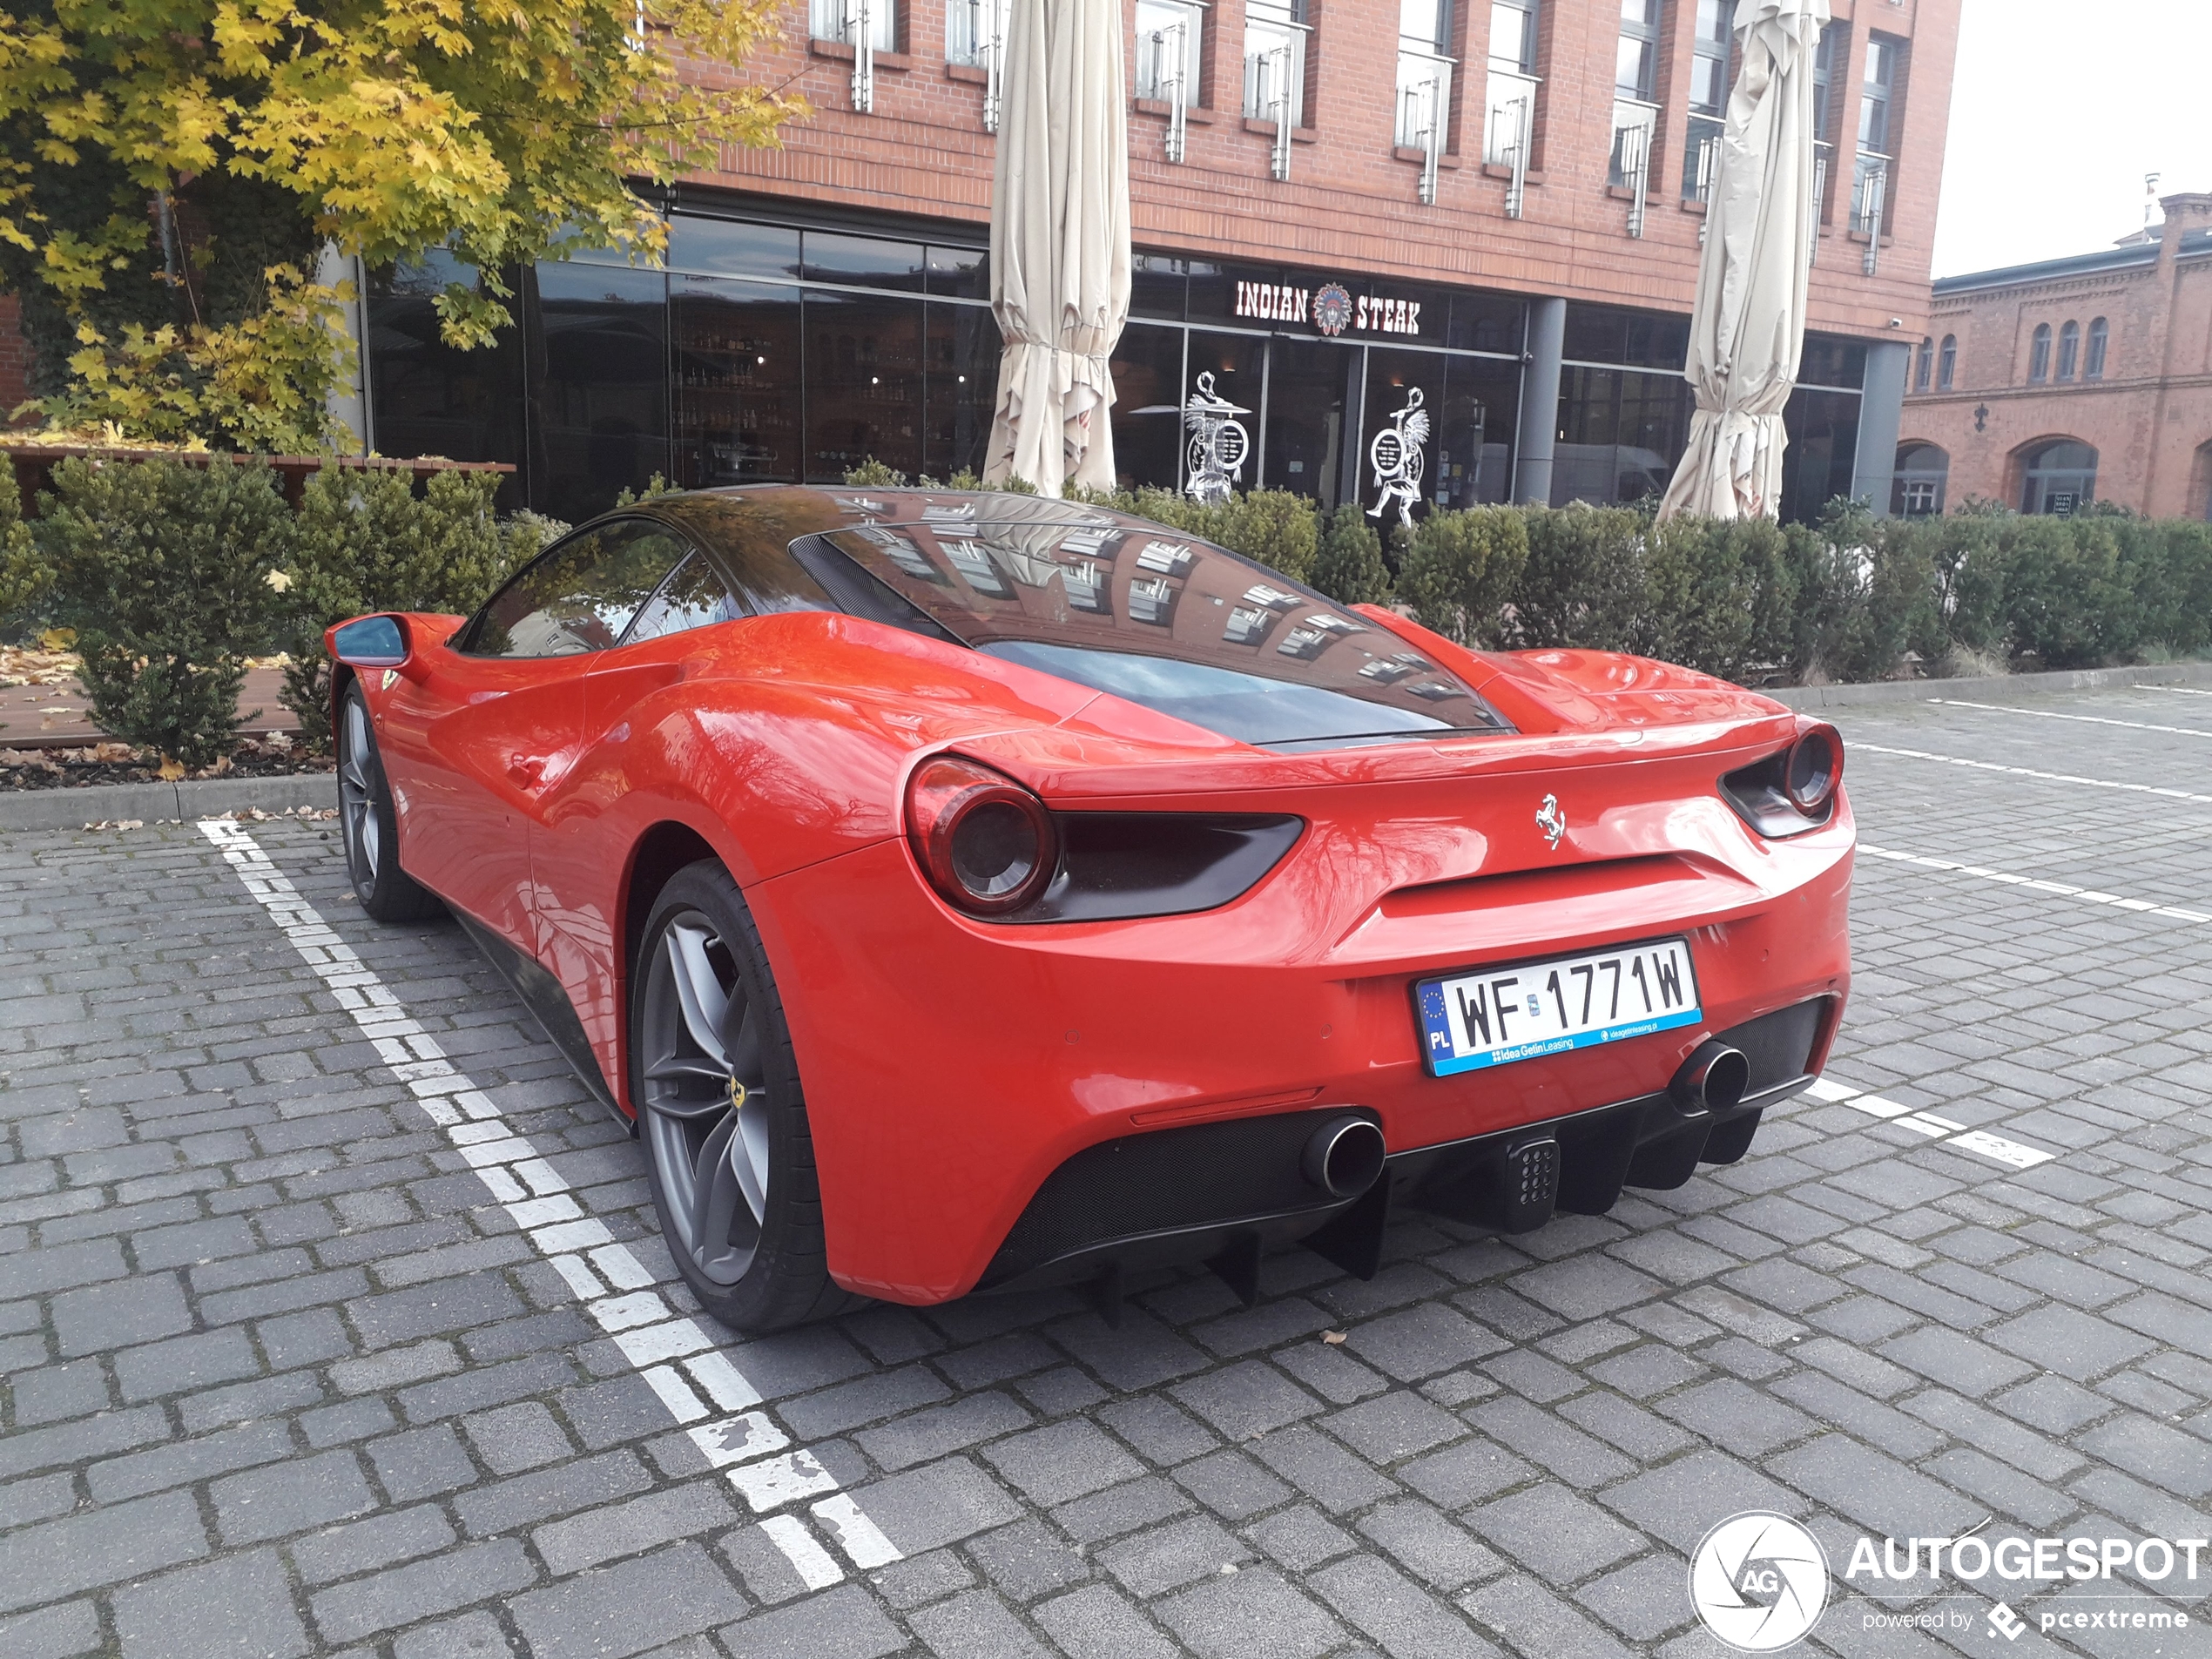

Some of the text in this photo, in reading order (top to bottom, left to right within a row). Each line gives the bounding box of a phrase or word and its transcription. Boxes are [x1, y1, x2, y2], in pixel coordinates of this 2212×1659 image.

[1235, 280, 1421, 335] INDIAN STEAK
[1456, 949, 1683, 1048] WF 1771W
[1430, 1031, 1450, 1050] PL
[1501, 1049, 1521, 1061] Idea
